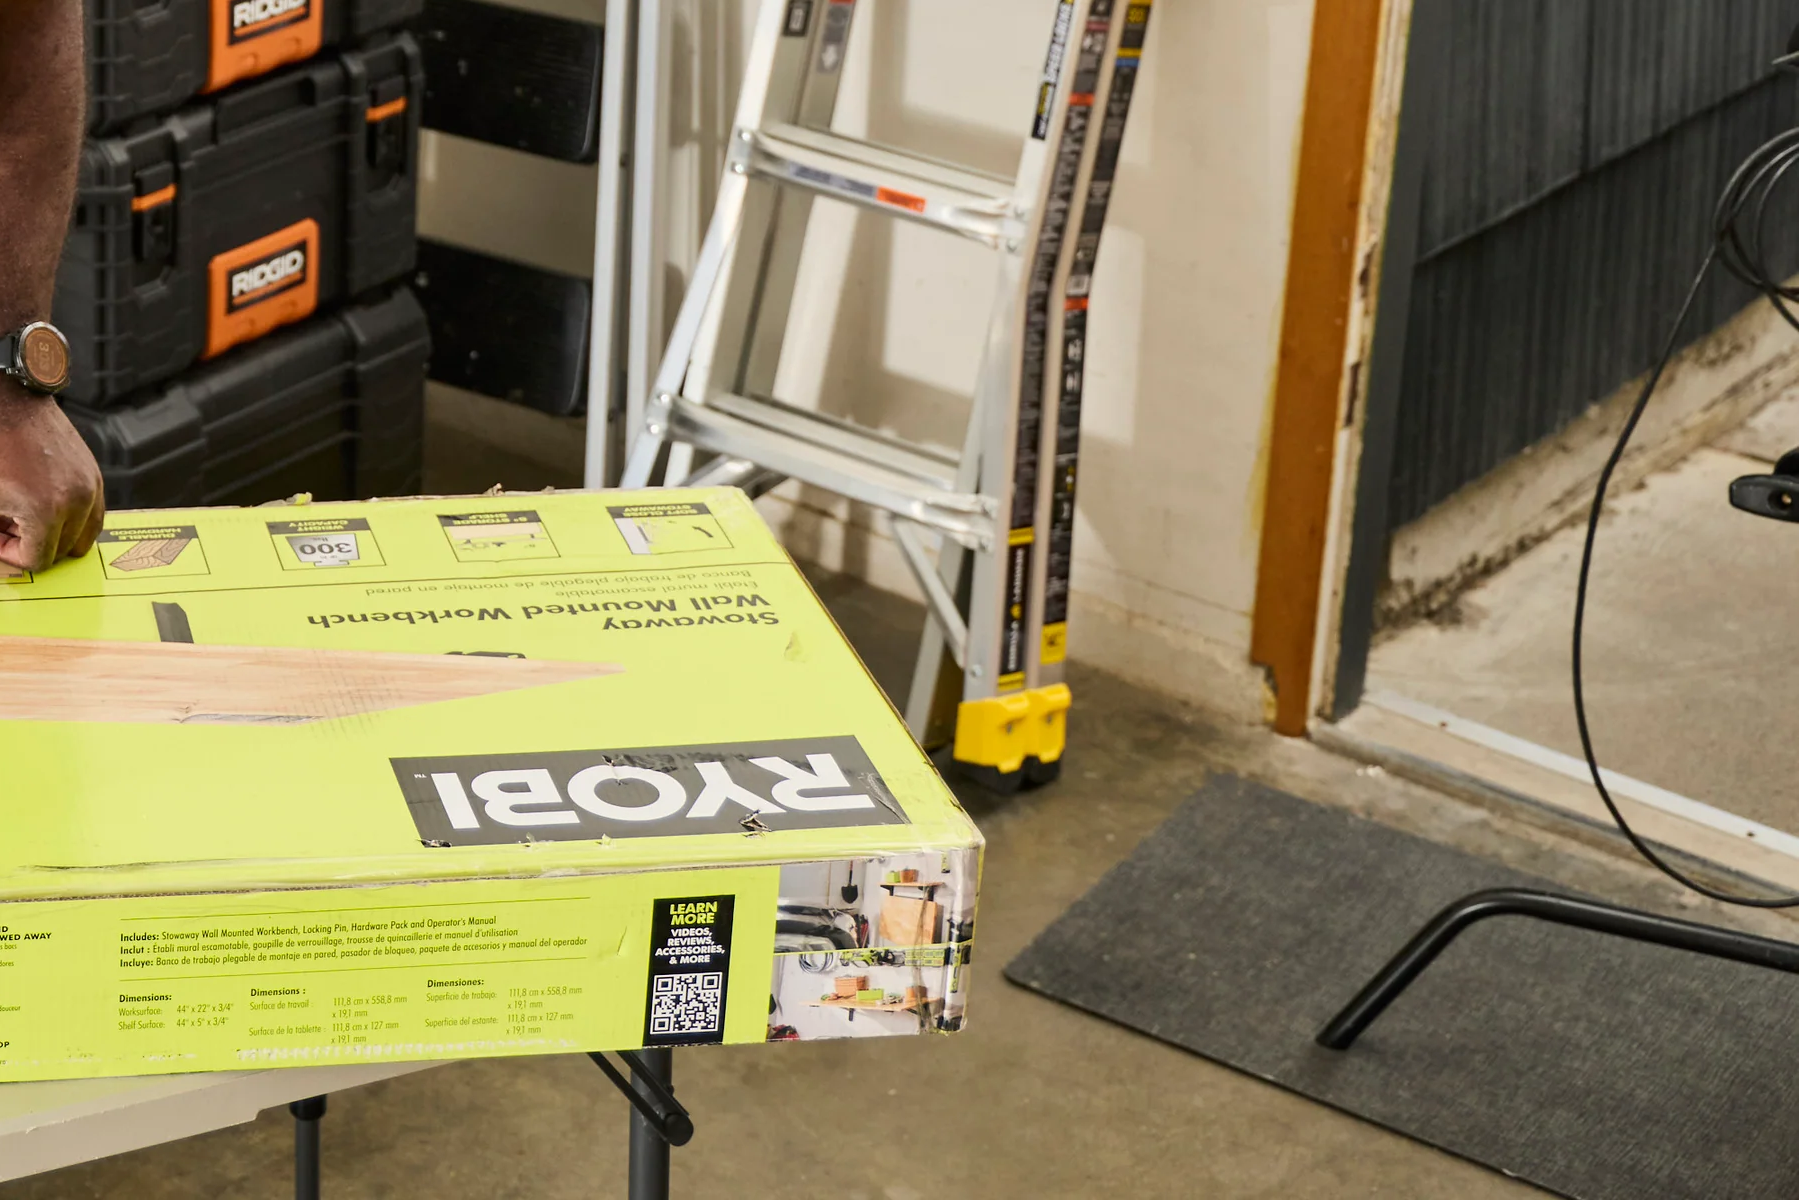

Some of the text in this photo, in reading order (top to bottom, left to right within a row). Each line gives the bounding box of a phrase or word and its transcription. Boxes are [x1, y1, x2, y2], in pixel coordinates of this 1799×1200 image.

[231, 250, 304, 297] RIDGID
[289, 519, 349, 527] CAPACITY
[109, 527, 182, 536] HARDWOOD
[118, 533, 176, 541] DURABLE
[299, 542, 352, 555] 300
[307, 594, 770, 627] Wall Mounted Workbench
[602, 612, 779, 629] Stowaway
[431, 753, 875, 829] RYOBI
[670, 901, 717, 915] LEARN
[671, 913, 715, 925] MORE
[120, 916, 497, 942] Includes: Stowaway Wall Mounted Workbench, Locking Pin, Hardware Pack and Operator's Manual
[671, 927, 712, 937] VIDEOS,
[120, 945, 144, 954] Inclut
[152, 943, 174, 953] Établi
[176, 942, 199, 951] mural
[201, 941, 250, 950] escamotable,
[252, 939, 283, 950] goupille
[285, 938, 295, 947] de
[375, 934, 384, 942] de
[387, 932, 432, 943] quincaillerie
[444, 930, 472, 939] manuel
[667, 937, 715, 947] REVIEWS,
[119, 958, 153, 968] Incluye:
[155, 957, 179, 965] Banco
[181, 956, 190, 964] de
[193, 955, 220, 964] trabajo
[222, 953, 255, 964] plegable
[257, 952, 267, 961] de
[269, 952, 300, 960] montaje
[340, 948, 370, 958] pasador
[373, 947, 382, 955] de
[419, 945, 449, 954] paquete
[451, 942, 461, 951] de
[463, 942, 500, 950] accesorios
[508, 939, 537, 948] manual
[539, 938, 551, 946] del
[553, 937, 587, 947] operador
[655, 945, 725, 956] ACCESSORIES,
[680, 955, 711, 964] MORE
[427, 979, 483, 987] Dimensiones:
[250, 988, 299, 996] Dimensions
[119, 994, 171, 1002] Dimensions:
